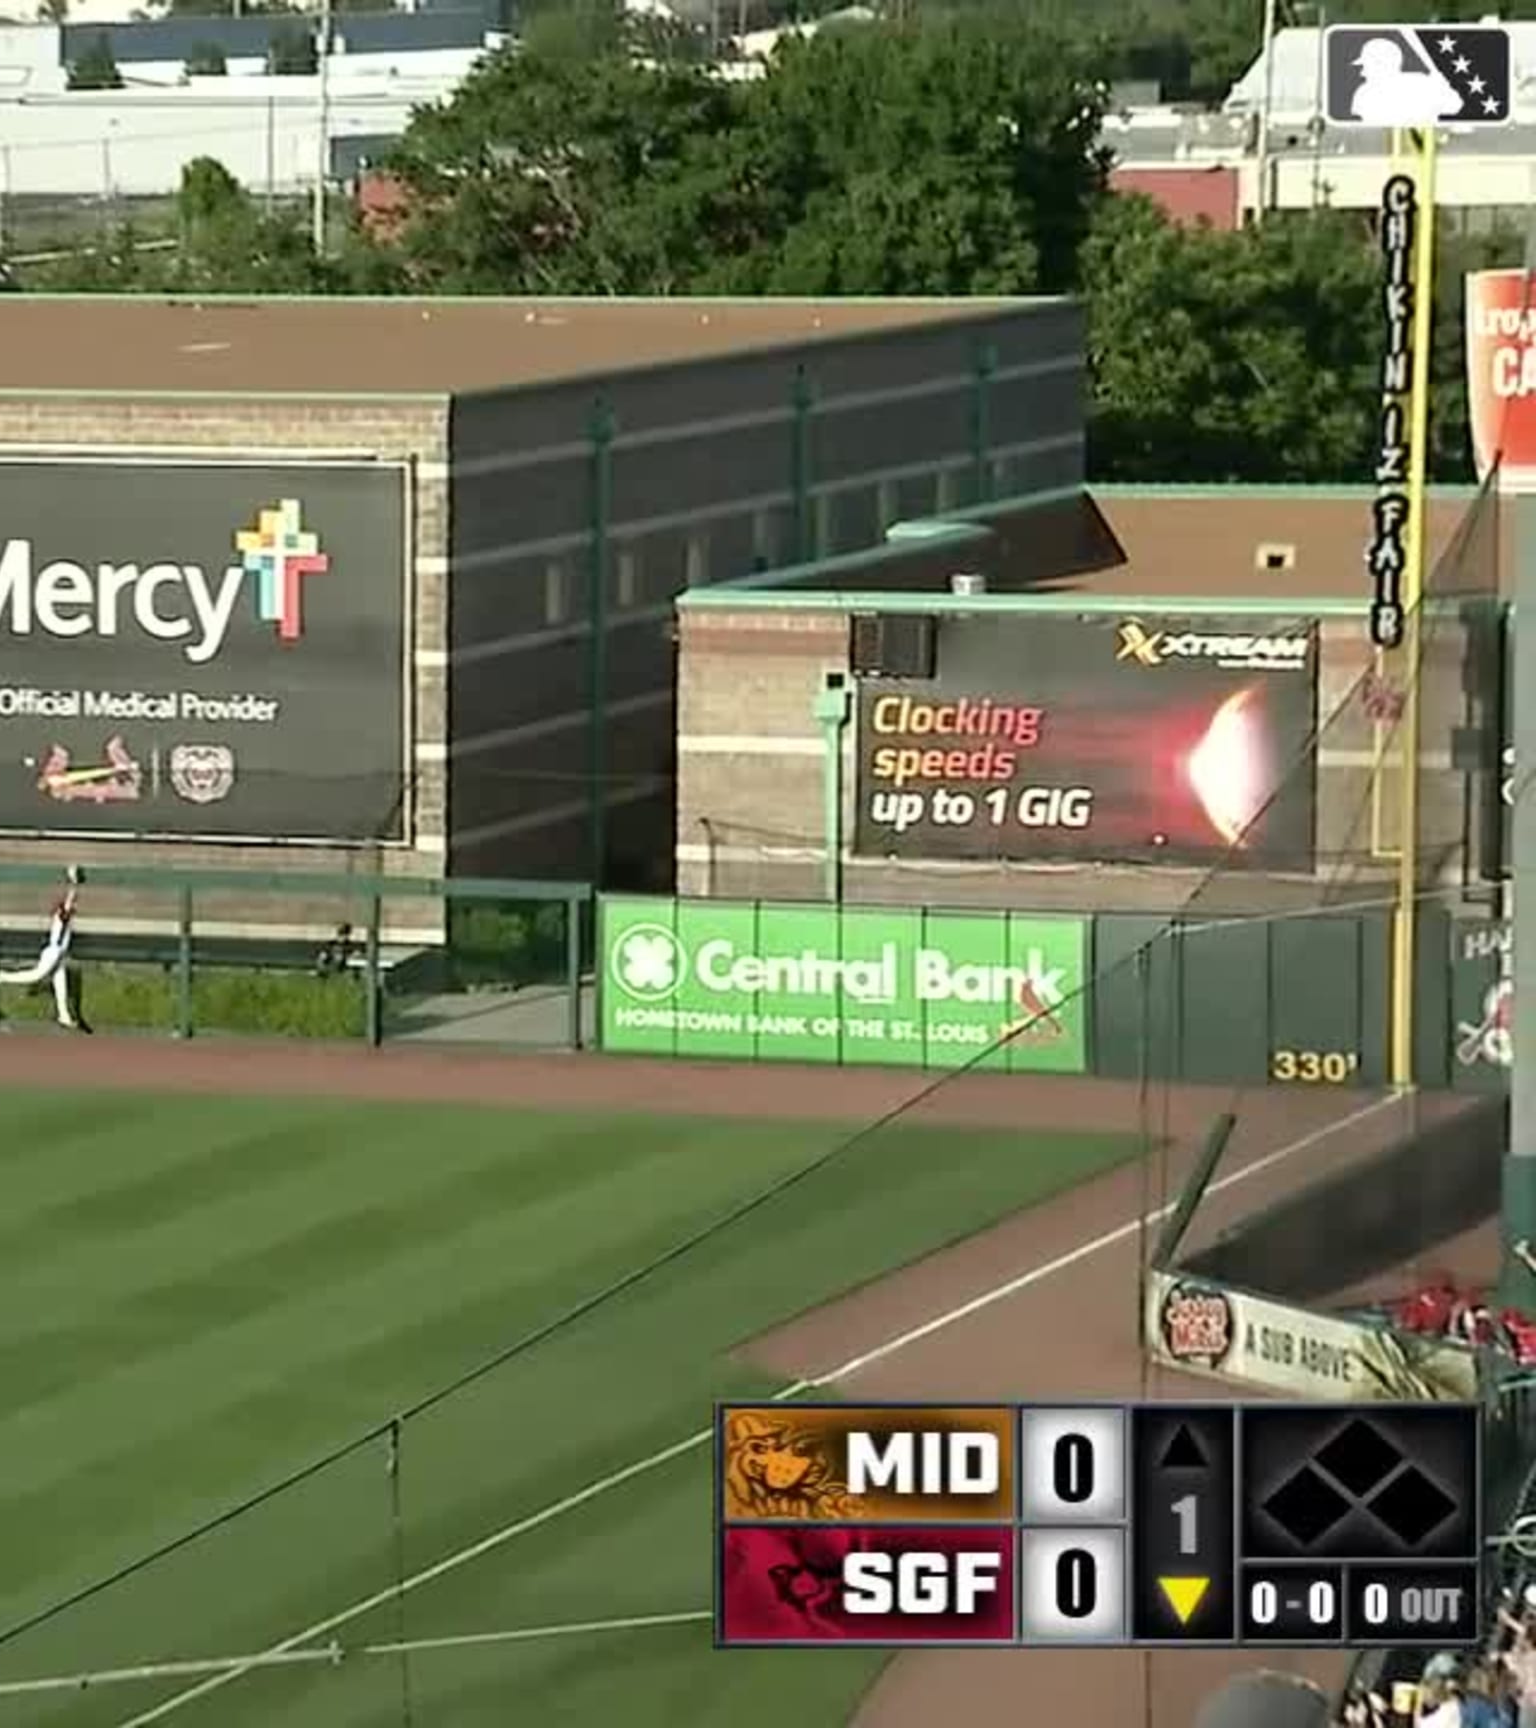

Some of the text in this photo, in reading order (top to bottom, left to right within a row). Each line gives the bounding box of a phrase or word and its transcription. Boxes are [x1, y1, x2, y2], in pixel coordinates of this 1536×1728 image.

[1373, 503, 1405, 640] FAIR
[84, 691, 177, 719] Medical
[182, 693, 278, 721] Provider
[873, 696, 1042, 744] Clocking
[873, 743, 1016, 786] speeds
[871, 789, 1092, 831] up to 1 GIG
[696, 940, 1066, 1003] Central Bank
[615, 1007, 990, 1045] HOMETOWN BANK OF THE ST. LOUIS
[1244, 1324, 1352, 1383] A SUB ABOVE
